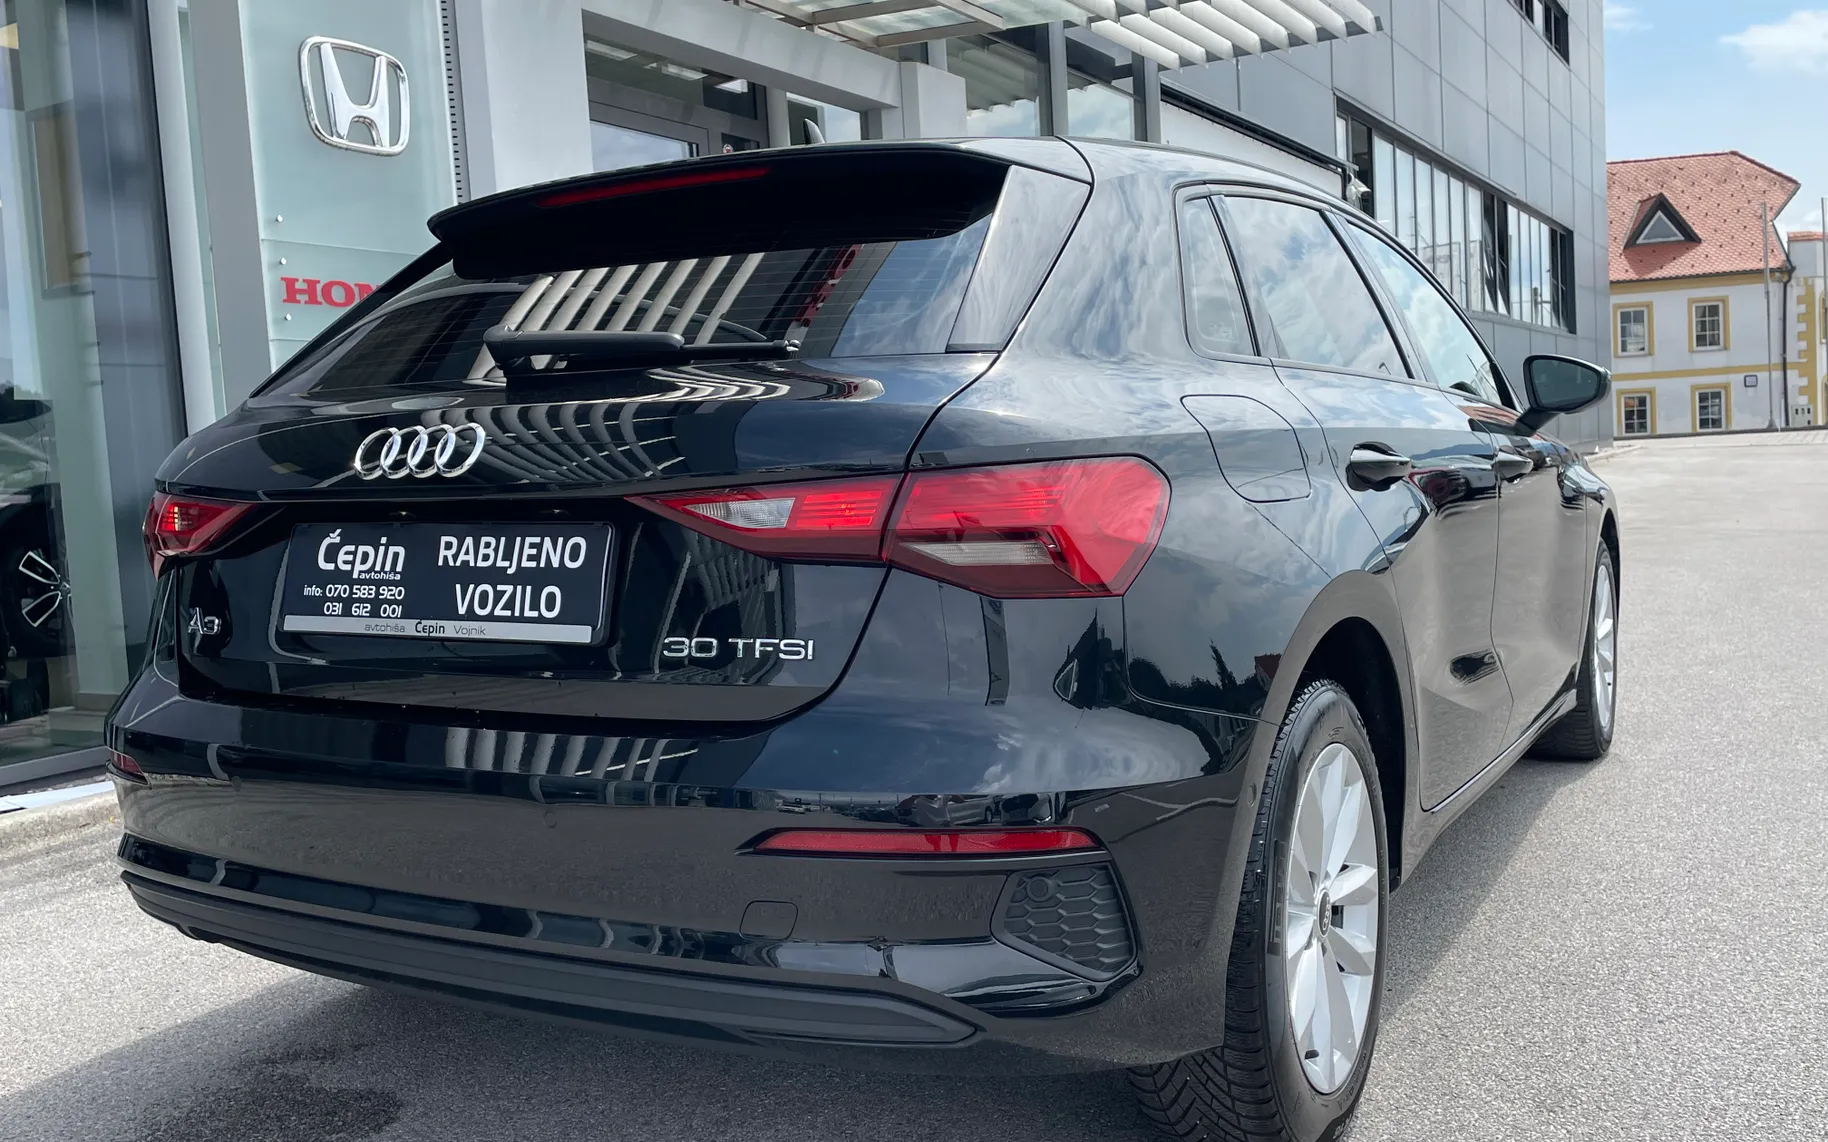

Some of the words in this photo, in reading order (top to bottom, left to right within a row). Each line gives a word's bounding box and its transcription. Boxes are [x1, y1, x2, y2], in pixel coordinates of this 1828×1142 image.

[317, 528, 406, 579] Čepin
[437, 535, 587, 575] RABLJENO
[359, 571, 401, 580] avtohiša
[303, 584, 323, 597] info:
[325, 584, 350, 598] 070
[352, 585, 376, 599] 583
[378, 586, 405, 600] 920
[455, 583, 562, 619] VOZILO
[187, 607, 222, 636] A3
[323, 602, 343, 616] 031
[351, 603, 372, 617] 612
[380, 604, 403, 618] 001
[364, 623, 406, 633] avtohiša
[453, 625, 487, 636] Vojnik
[662, 636, 718, 658] 30
[728, 638, 815, 660] TFSI
